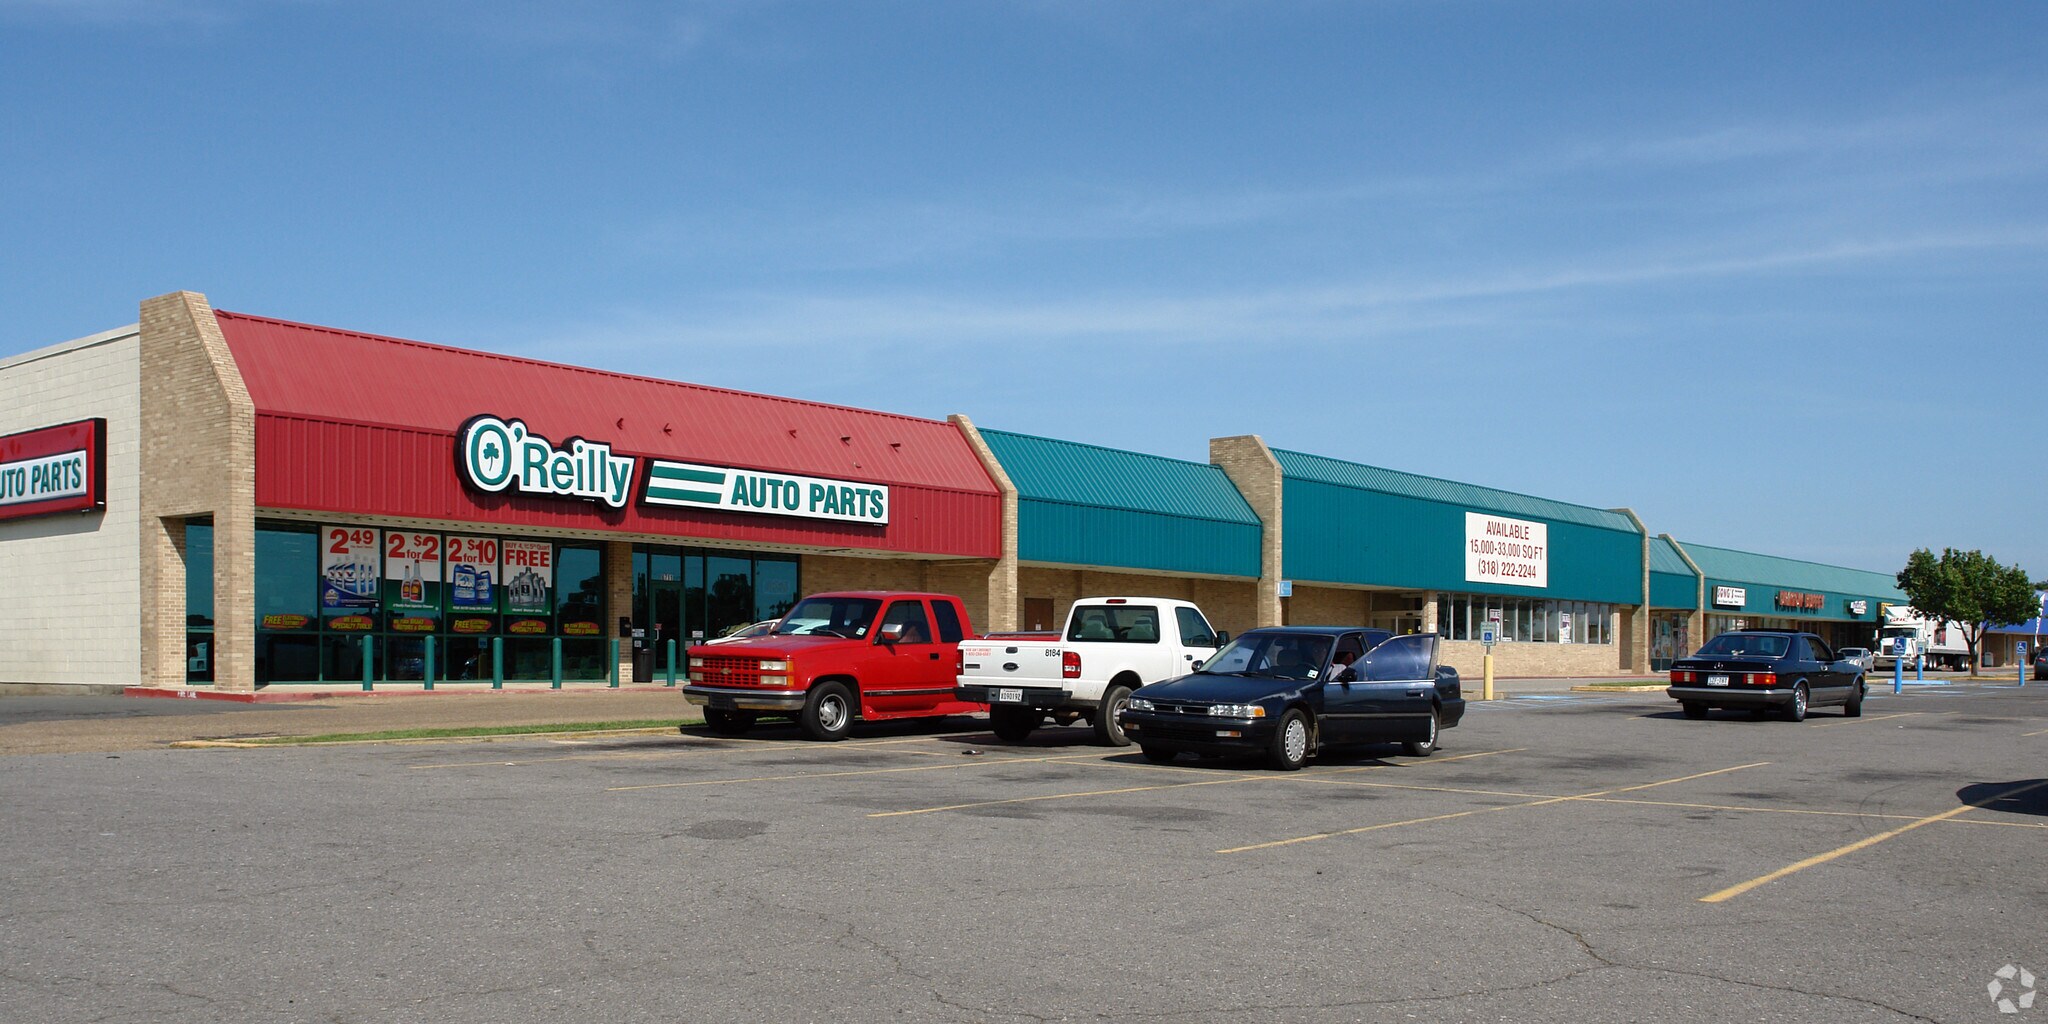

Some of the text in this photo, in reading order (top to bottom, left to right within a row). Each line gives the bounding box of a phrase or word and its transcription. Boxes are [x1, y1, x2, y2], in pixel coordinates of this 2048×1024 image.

[471, 424, 630, 502] O'Reilly
[31, 457, 81, 495] PARTS
[731, 475, 884, 519] AUTO PARTS
[1486, 521, 1529, 540] AVAILABLE
[406, 549, 421, 558] for
[463, 553, 477, 562] for
[505, 549, 550, 567] FREE
[1470, 539, 1543, 560] 15,000-33,000 SQ FT
[1478, 558, 1536, 578] (318) 222-2244
[263, 615, 283, 625] FREE
[454, 620, 469, 628] FREE
[1045, 649, 1061, 657] 8184
